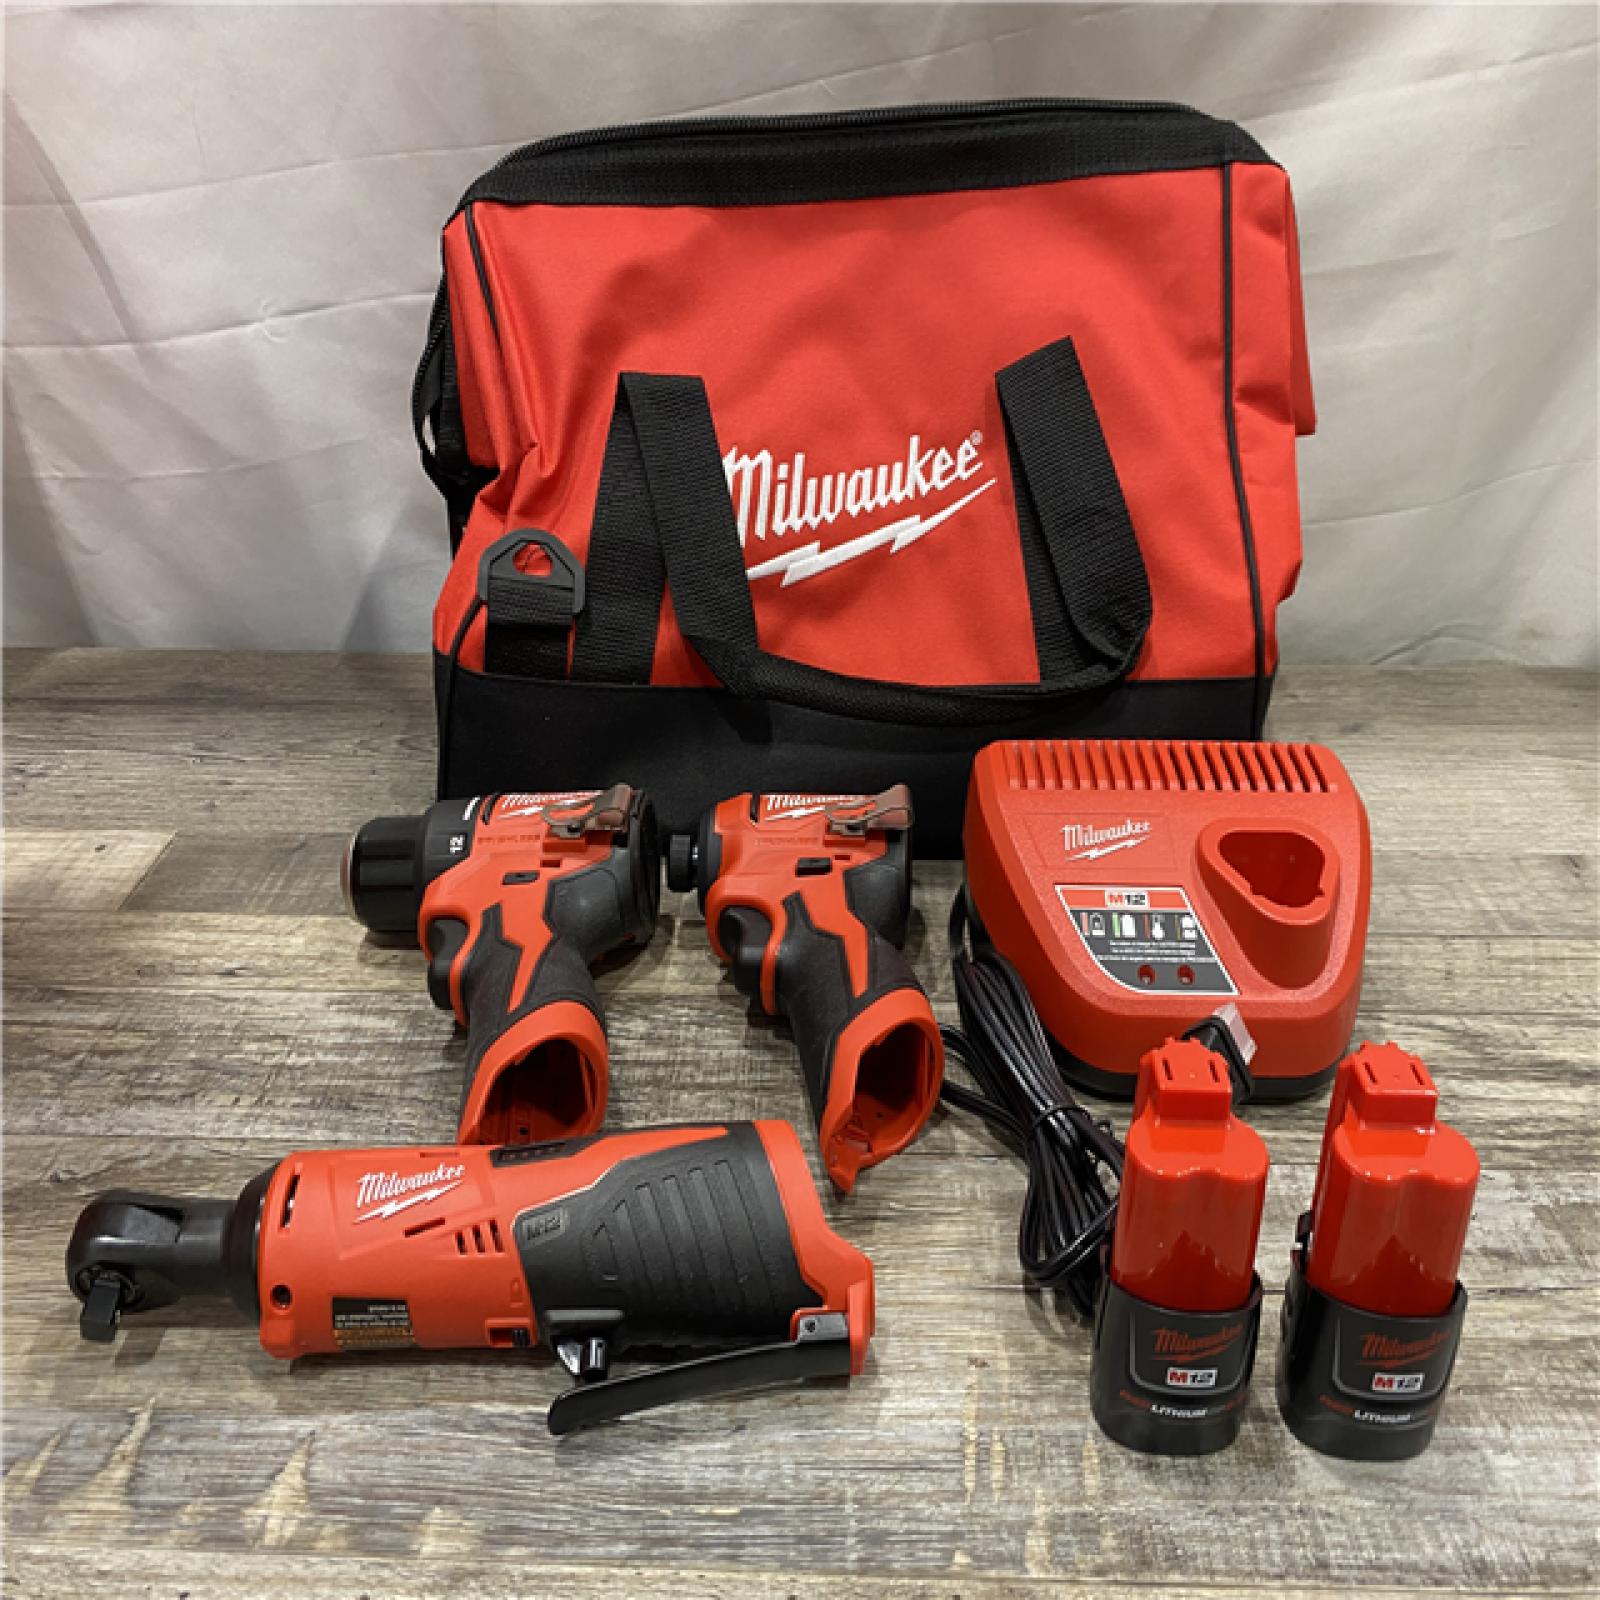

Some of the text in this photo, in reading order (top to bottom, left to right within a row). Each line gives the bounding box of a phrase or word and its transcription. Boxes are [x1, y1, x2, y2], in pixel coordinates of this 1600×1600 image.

[722, 435, 983, 548] Milwaukee
[1061, 819, 1152, 851] Milwaukee
[1108, 894, 1146, 906] M12
[357, 1162, 465, 1209] Milwaukee
[1169, 1371, 1214, 1384] M12
[1374, 1376, 1420, 1389] M12
